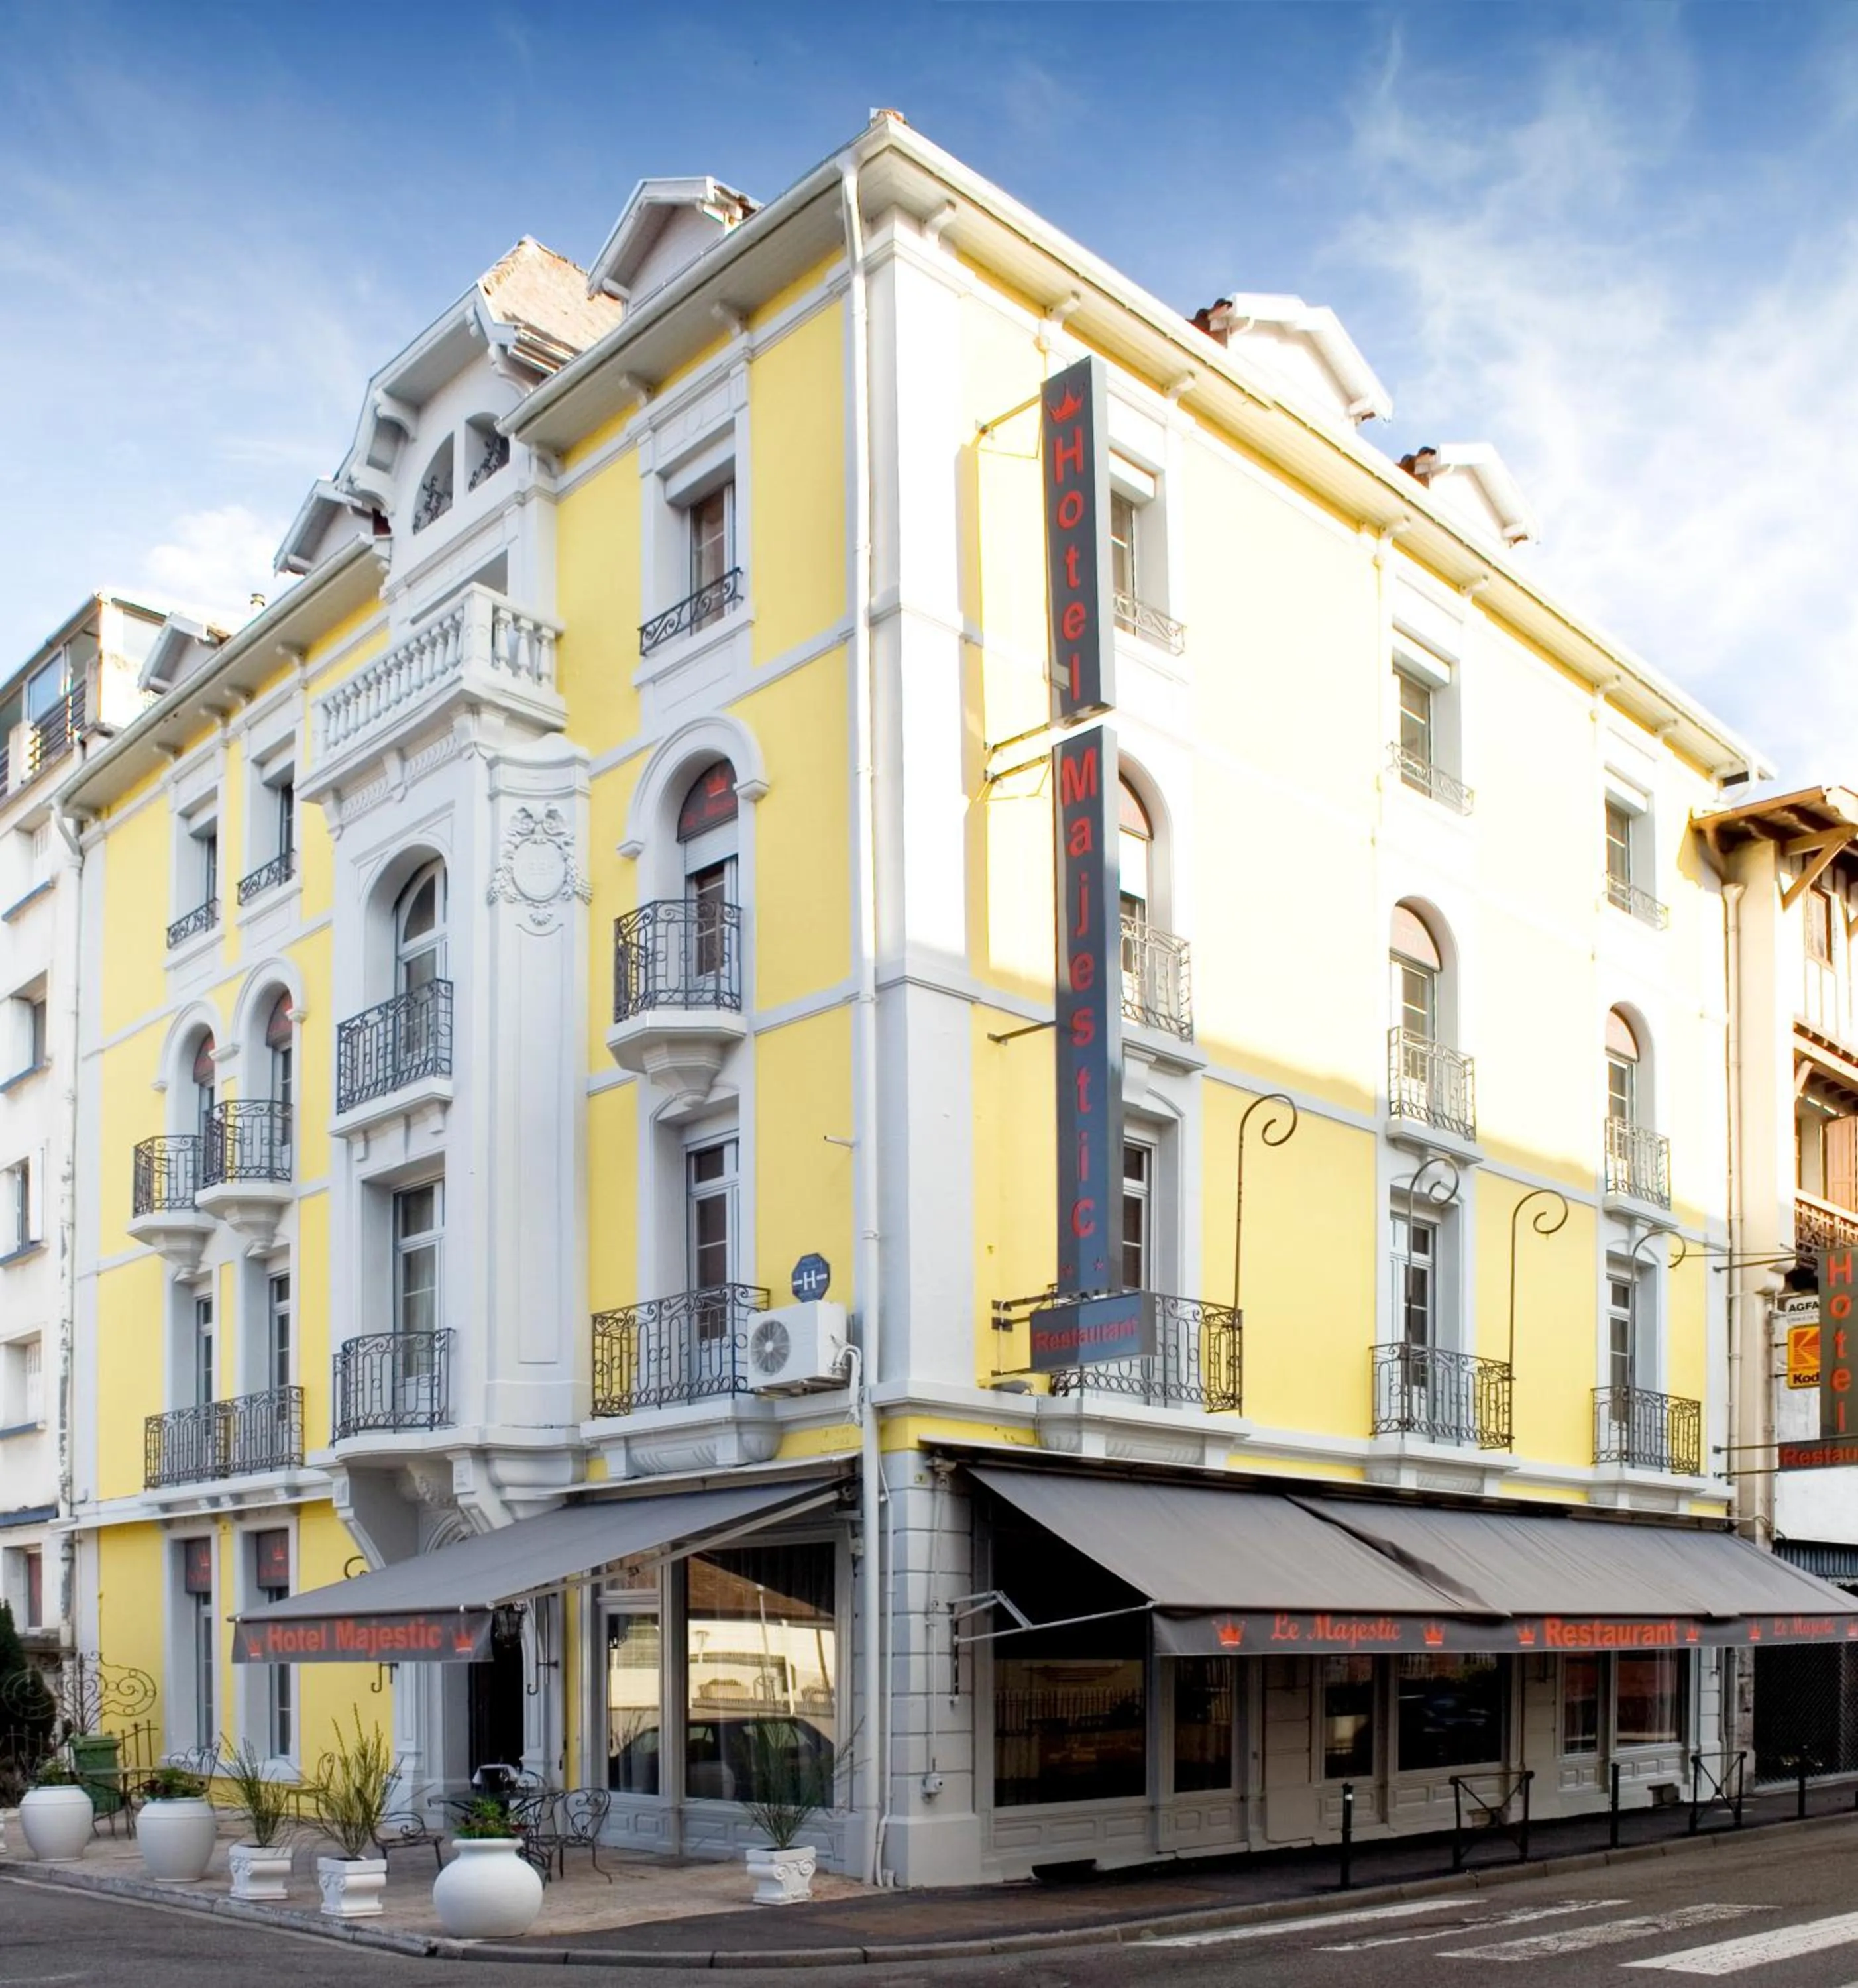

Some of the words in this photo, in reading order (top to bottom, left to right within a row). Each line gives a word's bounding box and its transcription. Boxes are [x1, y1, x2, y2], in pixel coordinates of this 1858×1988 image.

[1053, 425, 1087, 700] Hotel
[1062, 746, 1097, 1238] Majestic
[803, 1270, 816, 1290] H
[1788, 1301, 1820, 1313] AGFA
[1034, 1315, 1138, 1353] Restaurant
[1827, 1251, 1853, 1433] Hotel
[1792, 1372, 1820, 1384] Kod
[1782, 1445, 1858, 1468] Restau
[268, 1622, 327, 1653] Hotel
[335, 1617, 443, 1655] Majestic
[1270, 1614, 1301, 1641] Le
[1307, 1614, 1402, 1649] Majestic
[1544, 1618, 1679, 1647] Restaurant
